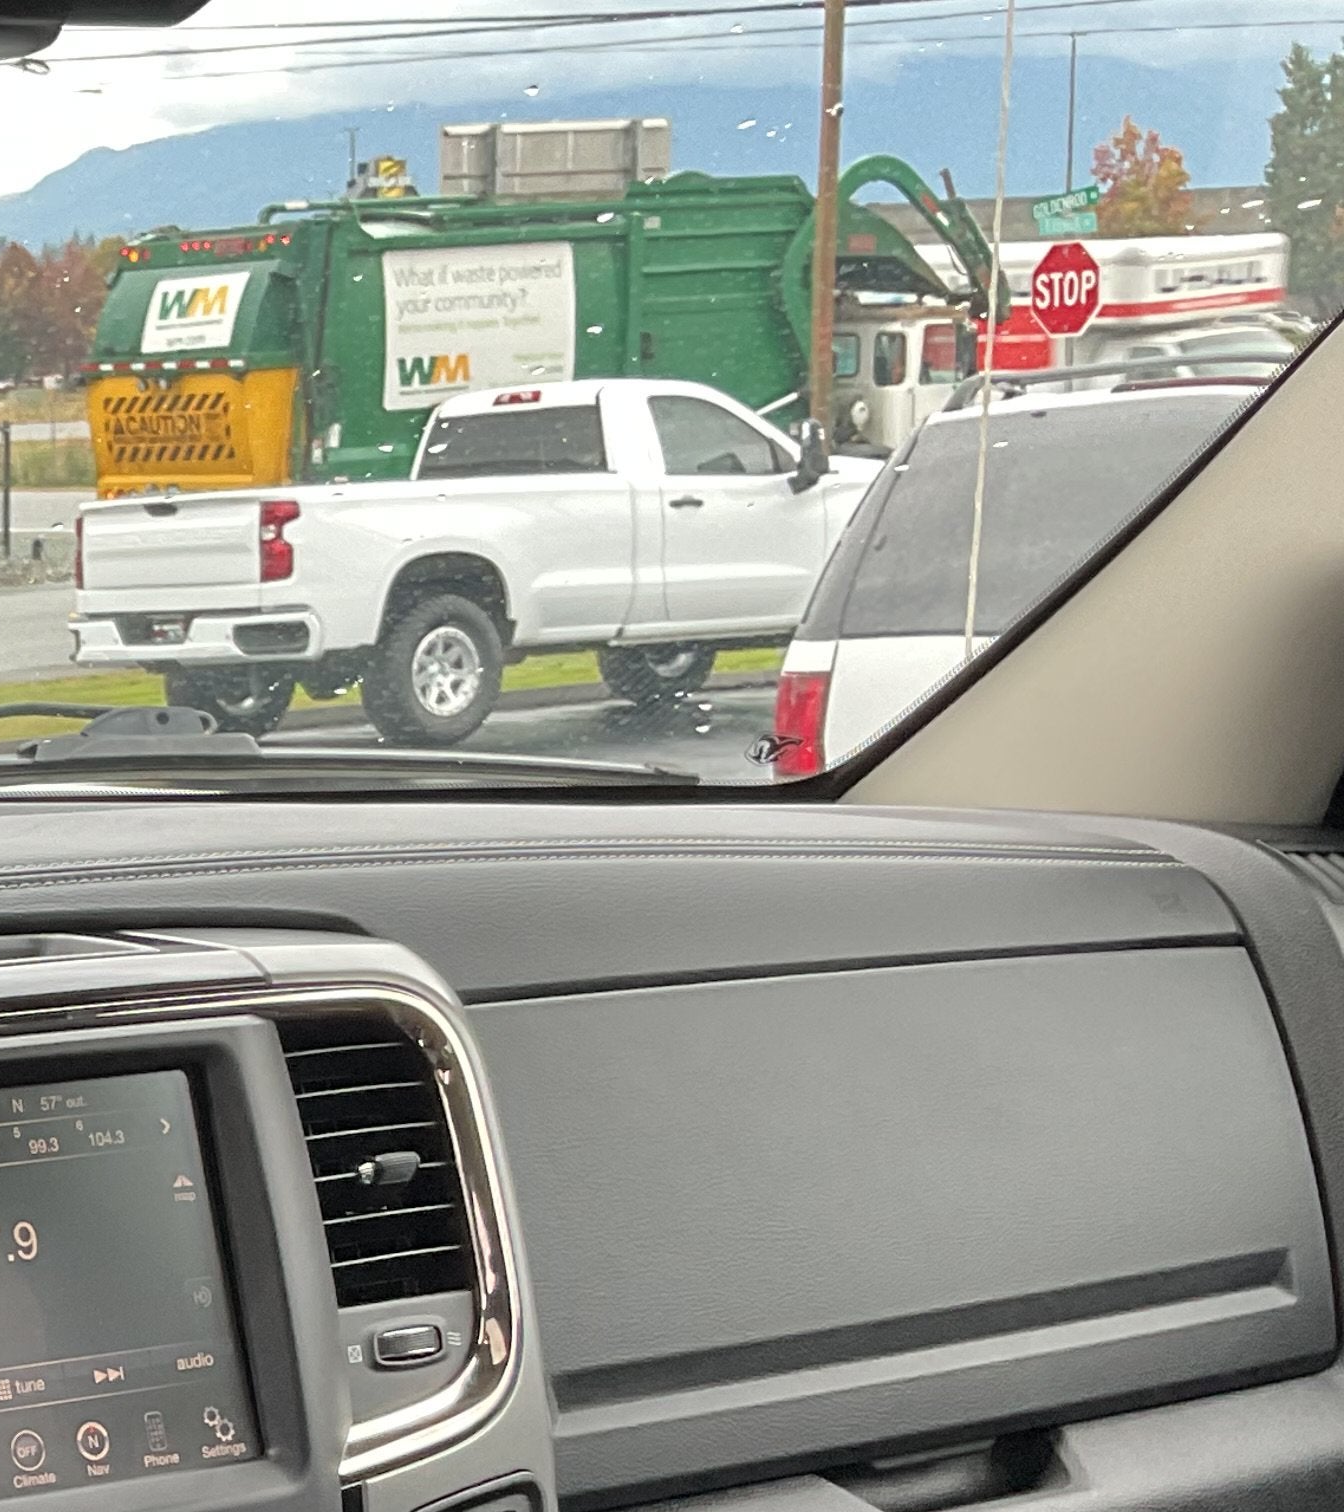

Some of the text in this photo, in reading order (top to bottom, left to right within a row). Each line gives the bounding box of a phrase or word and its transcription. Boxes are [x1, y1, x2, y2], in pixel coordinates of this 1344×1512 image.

[394, 259, 562, 287] What if waste powered
[1035, 269, 1096, 310] STOP
[159, 285, 229, 321] WM
[397, 288, 529, 321] your community?
[397, 353, 471, 387] WM
[125, 414, 200, 437] CAUTION
[11, 1099, 24, 1114] N
[13, 1126, 21, 1138] 5
[75, 1120, 83, 1132] 6
[28, 1137, 60, 1155] 99.3
[88, 1130, 125, 1147] 104.3
[177, 1352, 214, 1370] audio
[15, 1377, 46, 1394] tune
[88, 1436, 99, 1449] N
[201, 1441, 247, 1459] Settings
[16, 1446, 37, 1459] OFF
[144, 1453, 180, 1468] Phone
[87, 1463, 110, 1476] Nav
[13, 1472, 56, 1488] Climate
